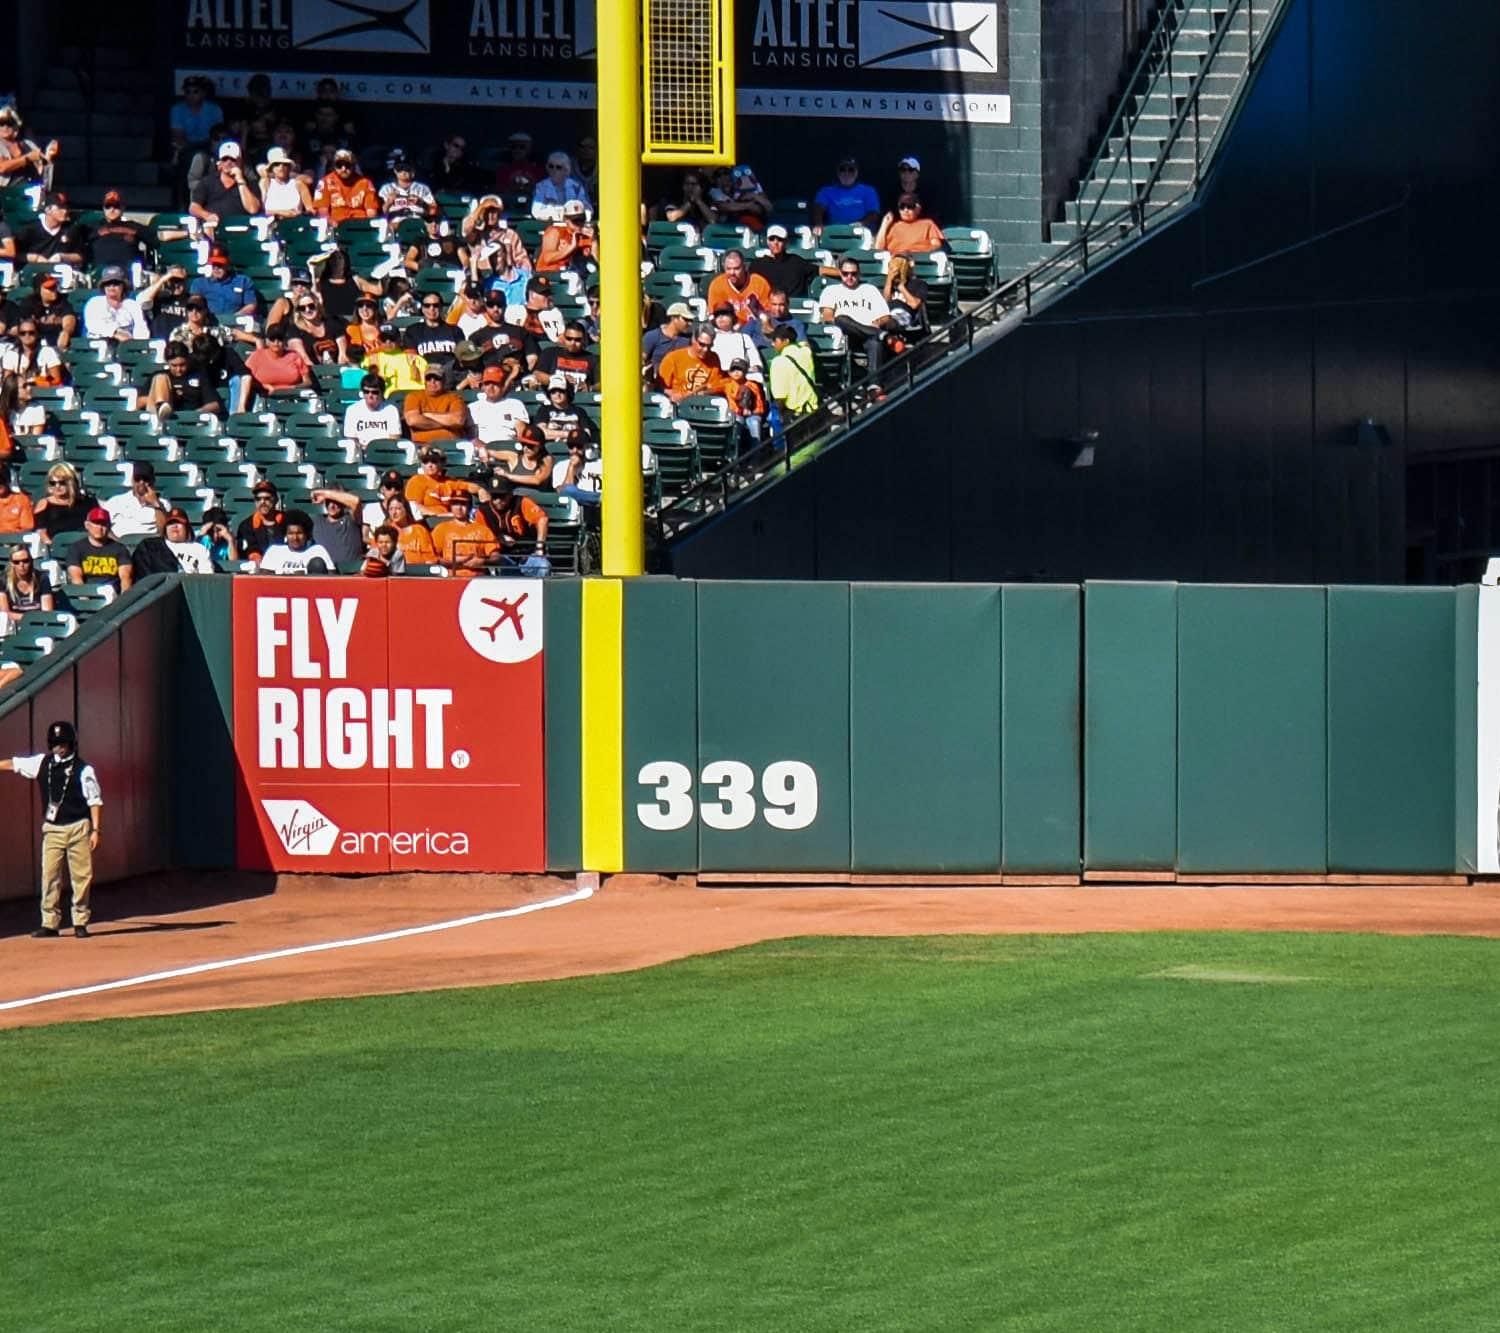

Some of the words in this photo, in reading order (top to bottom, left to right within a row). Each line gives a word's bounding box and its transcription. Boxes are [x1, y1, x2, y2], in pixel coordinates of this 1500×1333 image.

[752, 0, 856, 49] ALTEC
[186, 33, 290, 50] LANSING
[468, 43, 573, 60] LANSING
[752, 52, 857, 67] LANSING
[752, 95, 999, 113] ALTECLANSING.COM
[256, 596, 359, 679] FLY
[636, 760, 819, 831] 339
[280, 809, 329, 851] Virgin
[340, 828, 469, 855] america
